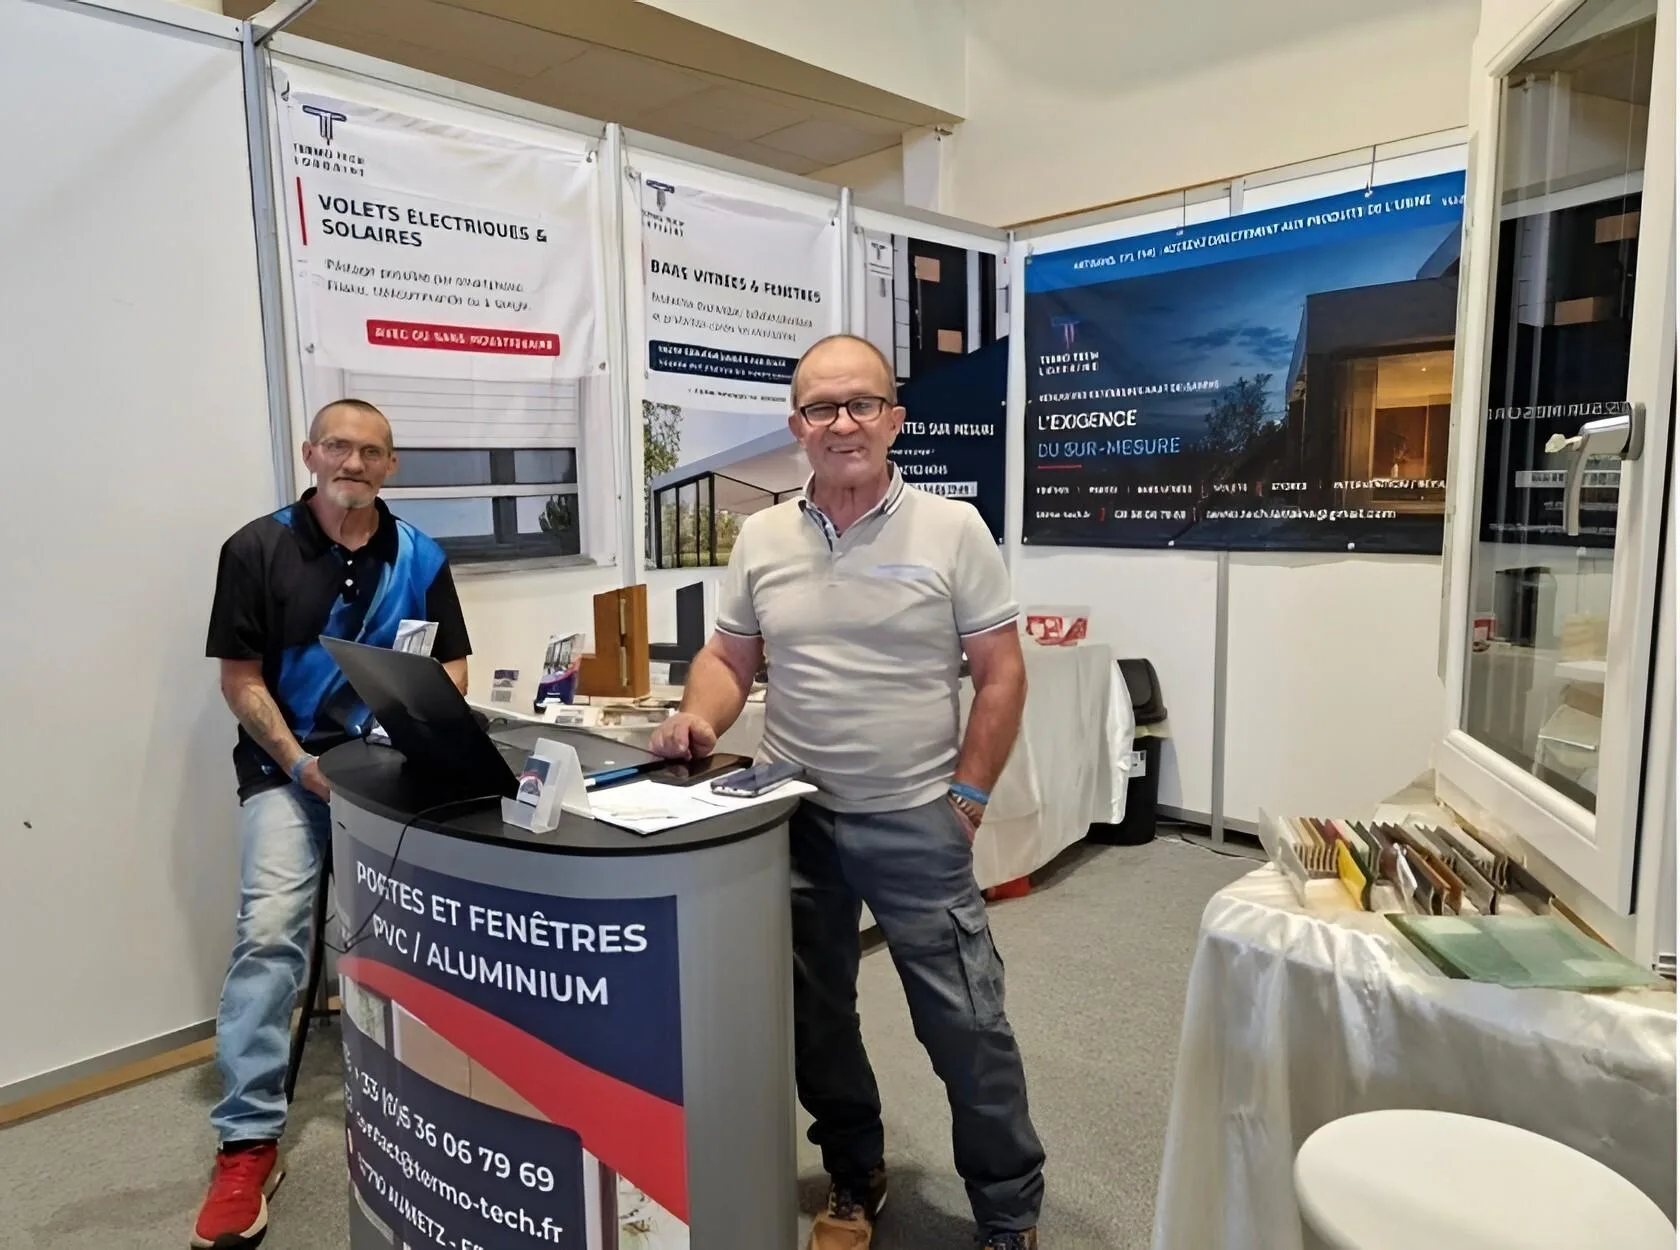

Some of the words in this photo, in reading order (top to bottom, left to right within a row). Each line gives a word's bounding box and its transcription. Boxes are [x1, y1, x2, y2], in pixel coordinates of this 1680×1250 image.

[318, 194, 400, 222] VOLETS
[322, 219, 422, 247] SOLAIRES
[1038, 442, 1059, 458] DU
[357, 860, 425, 915] PORTES
[432, 895, 461, 926] ET
[469, 905, 648, 953] FENÊTRES
[372, 912, 408, 955] PVC
[427, 942, 609, 1006] ALUMINIUM
[414, 1113, 437, 1147] 36
[443, 1132, 472, 1165] 06
[478, 1146, 511, 1179] 79
[519, 1161, 554, 1192] 69
